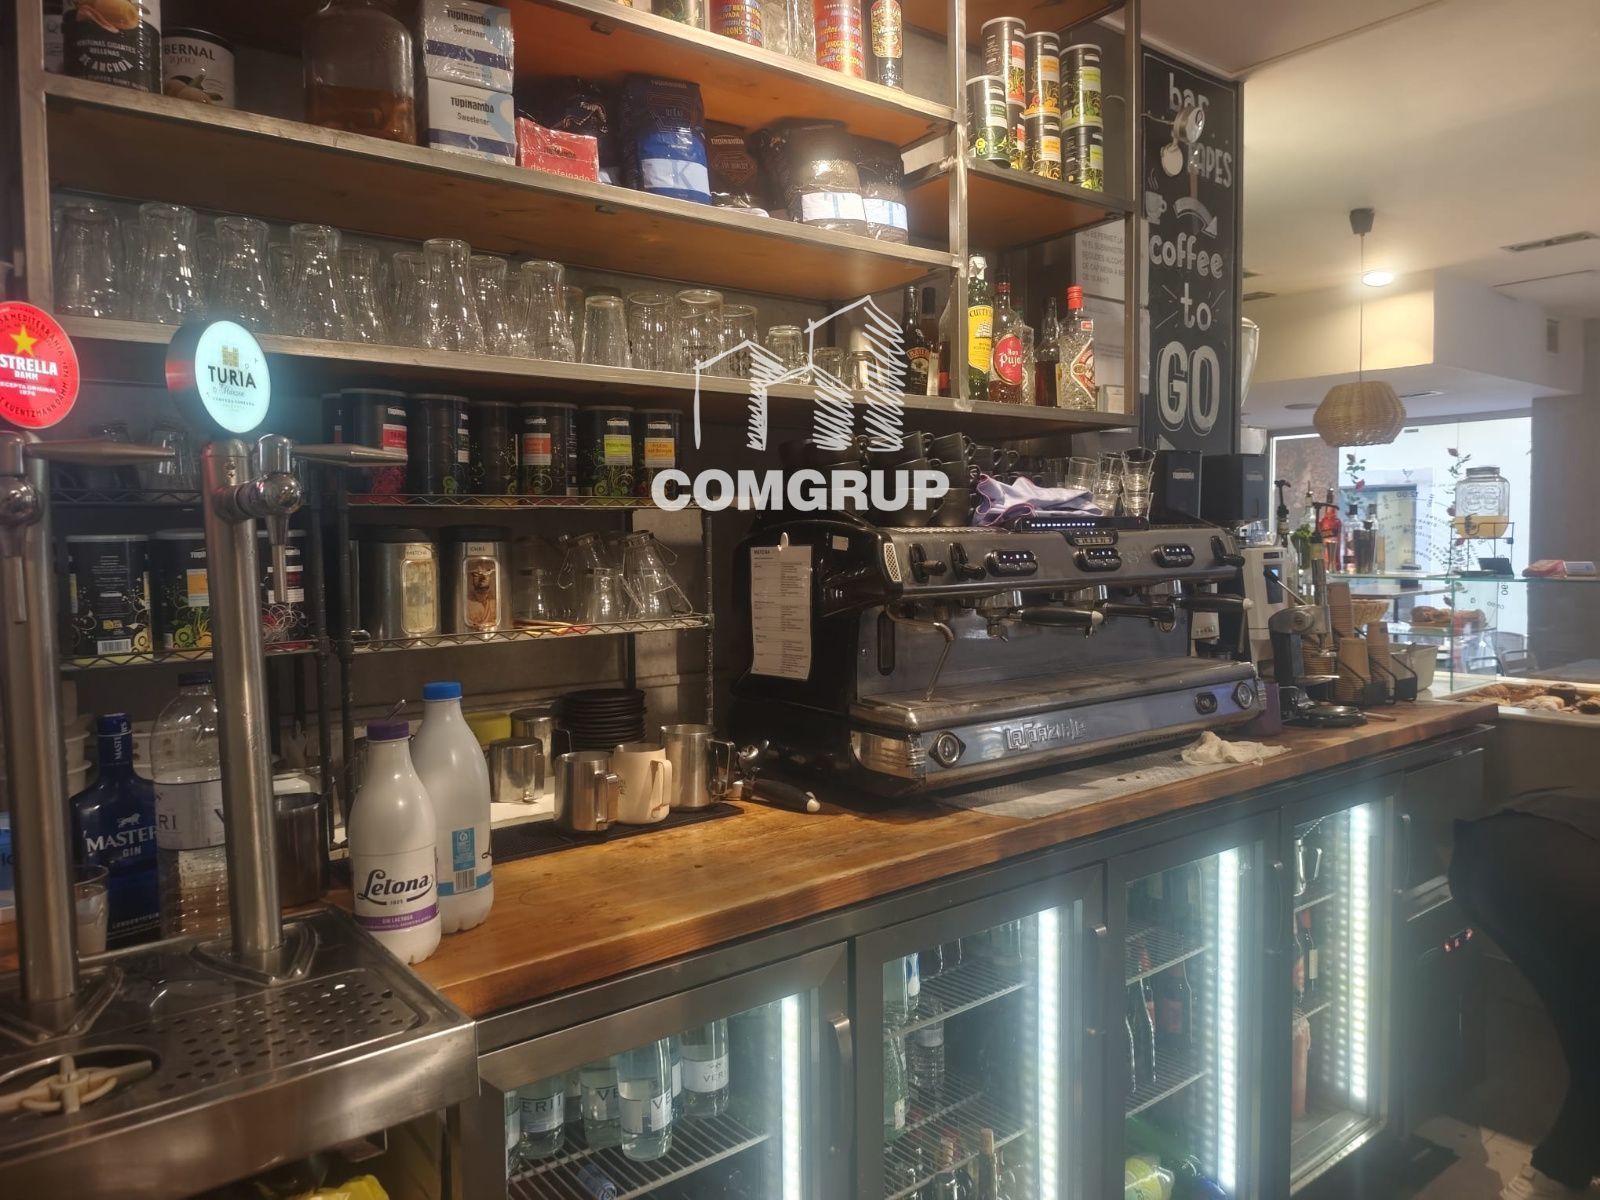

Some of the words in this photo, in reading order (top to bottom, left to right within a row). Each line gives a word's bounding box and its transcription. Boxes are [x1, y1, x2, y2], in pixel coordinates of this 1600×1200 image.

[164, 43, 216, 60] BERNAL
[92, 57, 134, 72] ANCHOA
[1169, 72, 1209, 113] bar
[457, 112, 491, 126] Sweetener
[1150, 232, 1223, 279] coffee
[1180, 282, 1212, 331] to
[0, 353, 58, 377] STRELLA
[14, 369, 38, 381] DAMM
[208, 365, 257, 389] TURIA
[1157, 340, 1220, 434] GO
[122, 846, 142, 858] GIN
[357, 869, 433, 900] Letona
